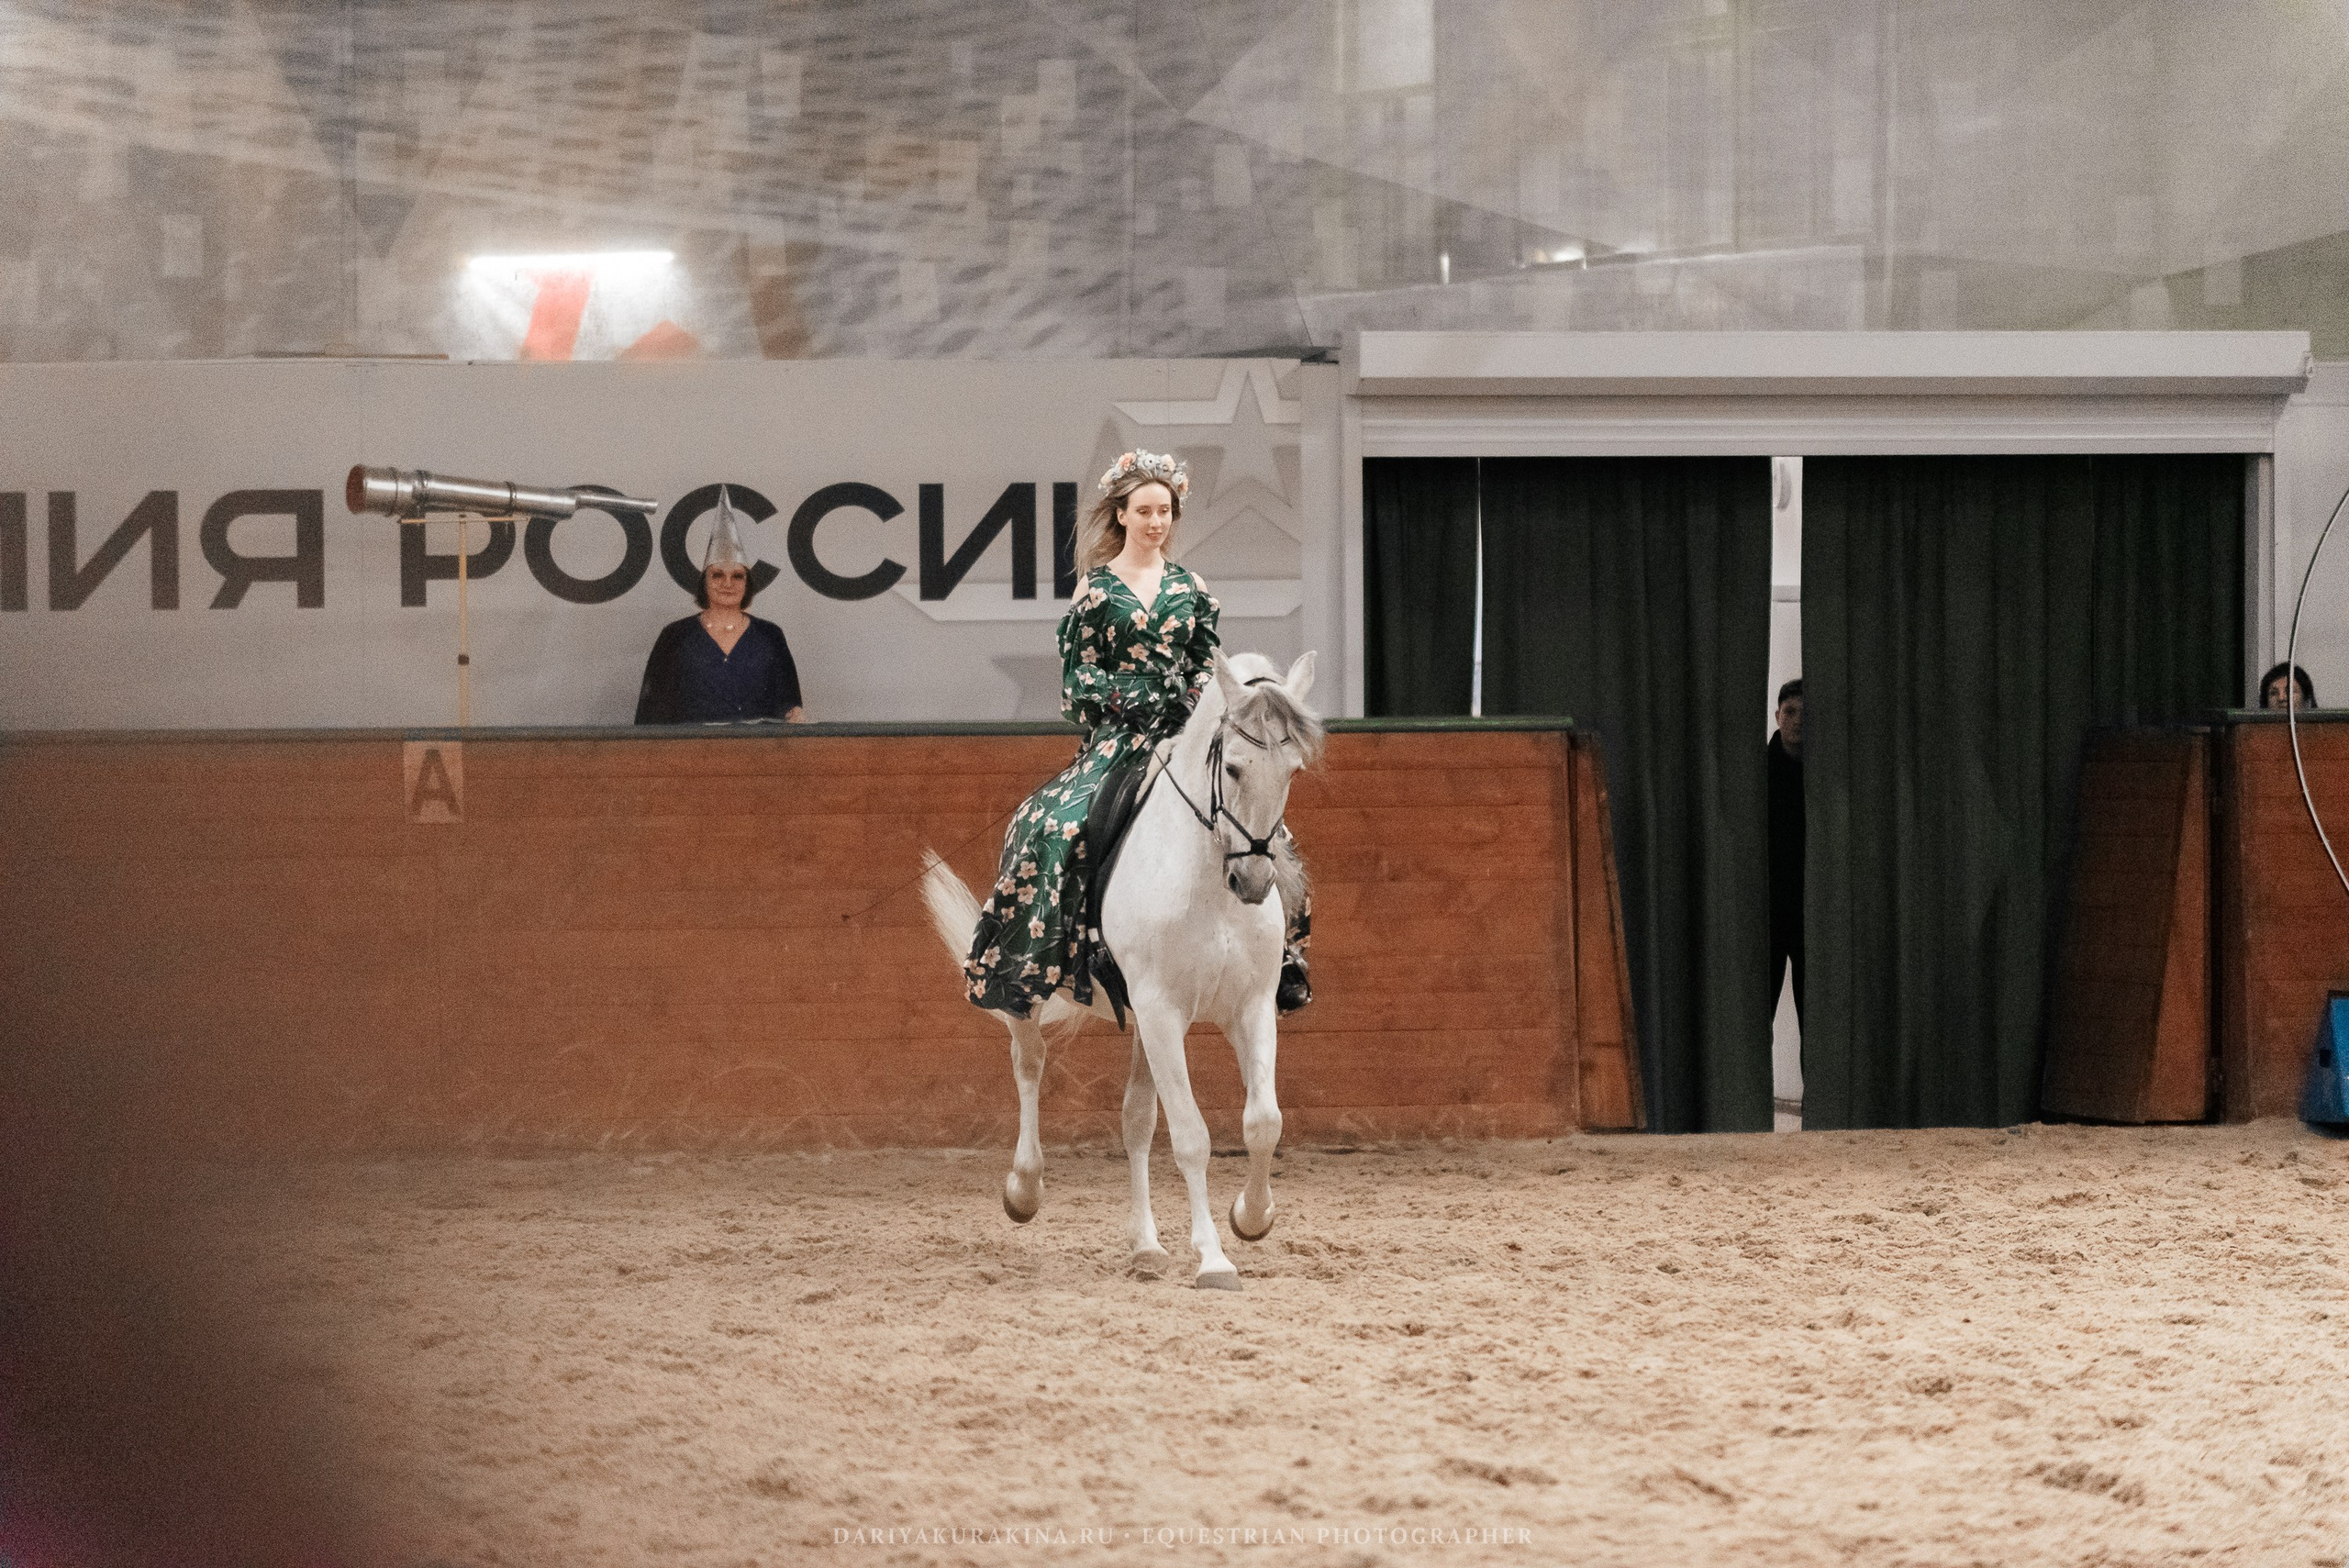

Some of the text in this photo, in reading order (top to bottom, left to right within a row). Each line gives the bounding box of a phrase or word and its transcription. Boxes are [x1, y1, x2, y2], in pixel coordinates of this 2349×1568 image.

[0, 482, 1077, 612] ИЯ РОССИ
[410, 749, 460, 816] A
